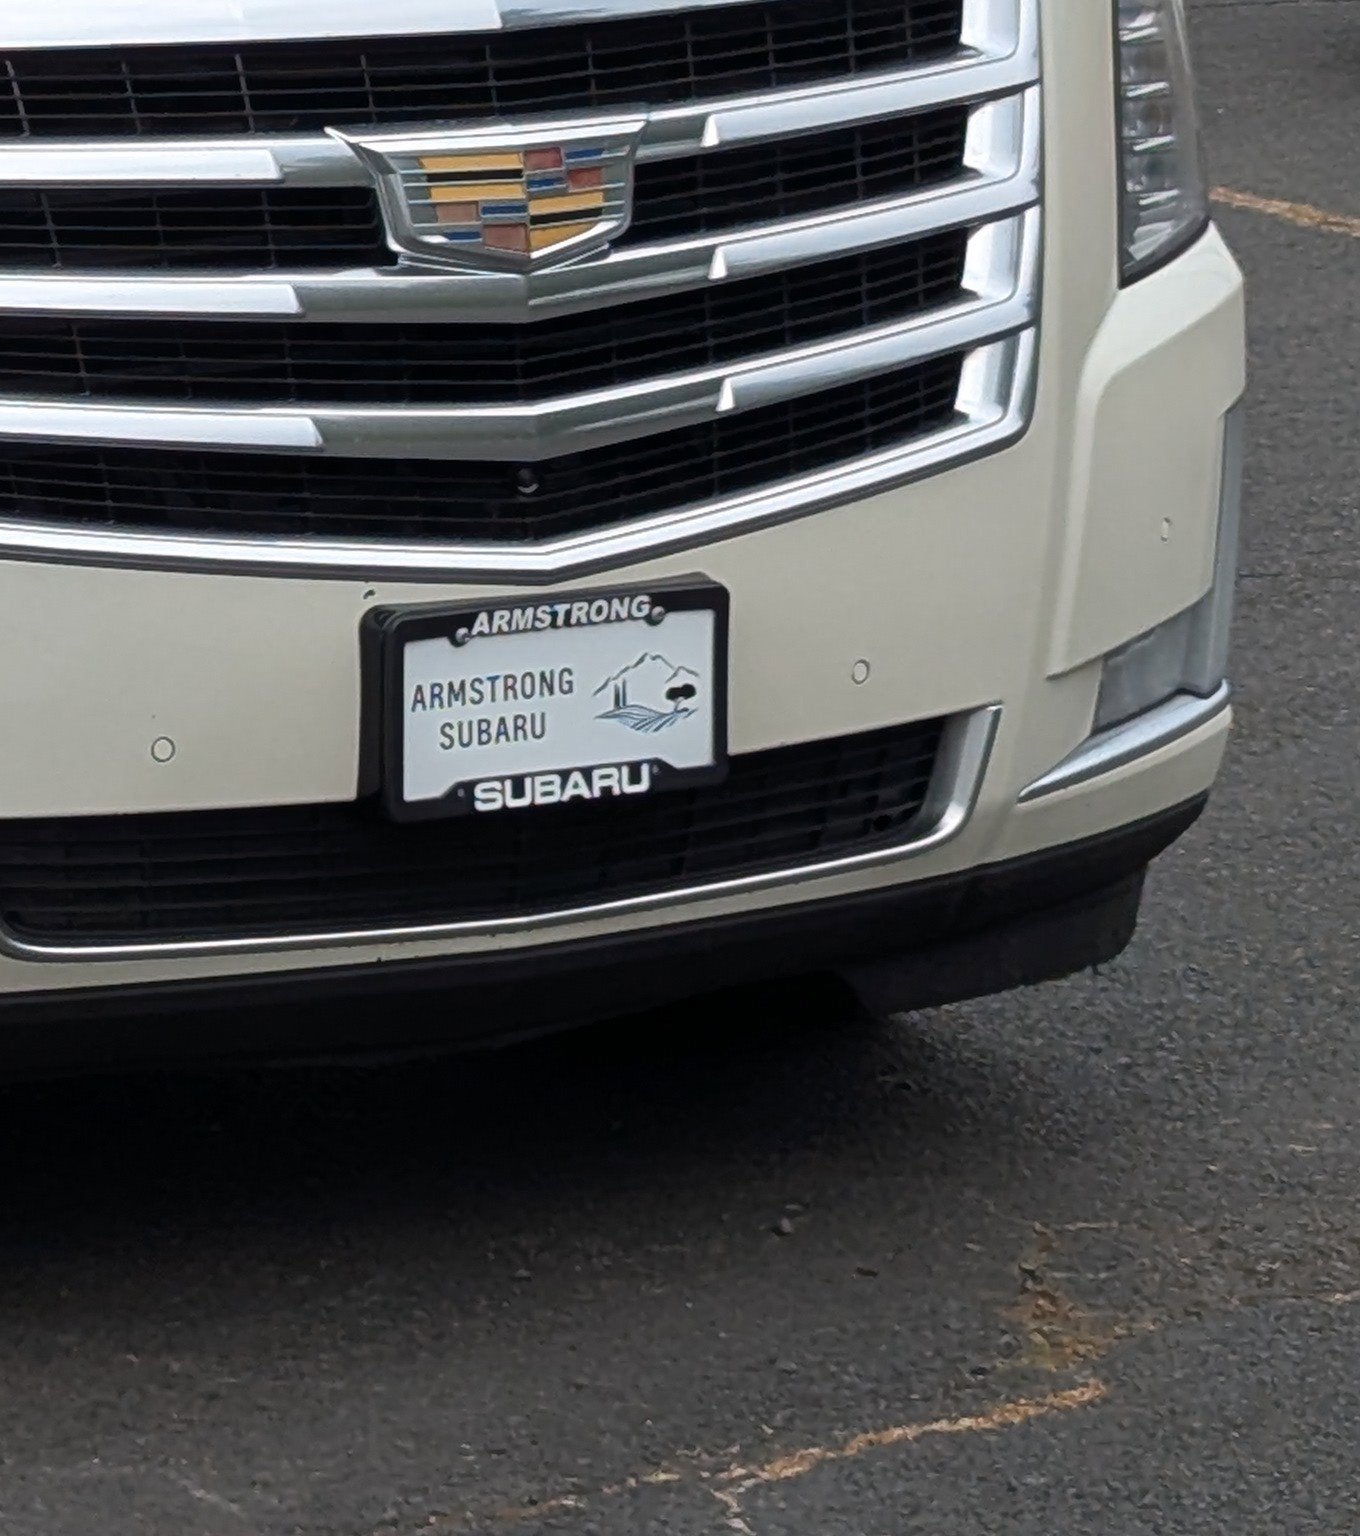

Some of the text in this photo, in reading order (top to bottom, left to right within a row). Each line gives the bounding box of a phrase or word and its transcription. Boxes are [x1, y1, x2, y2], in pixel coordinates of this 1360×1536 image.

[471, 595, 651, 636] ARMSTRONG
[411, 667, 574, 712] ARMSTRONG
[438, 711, 547, 751] SUBARU
[473, 763, 651, 812] SUBARU
